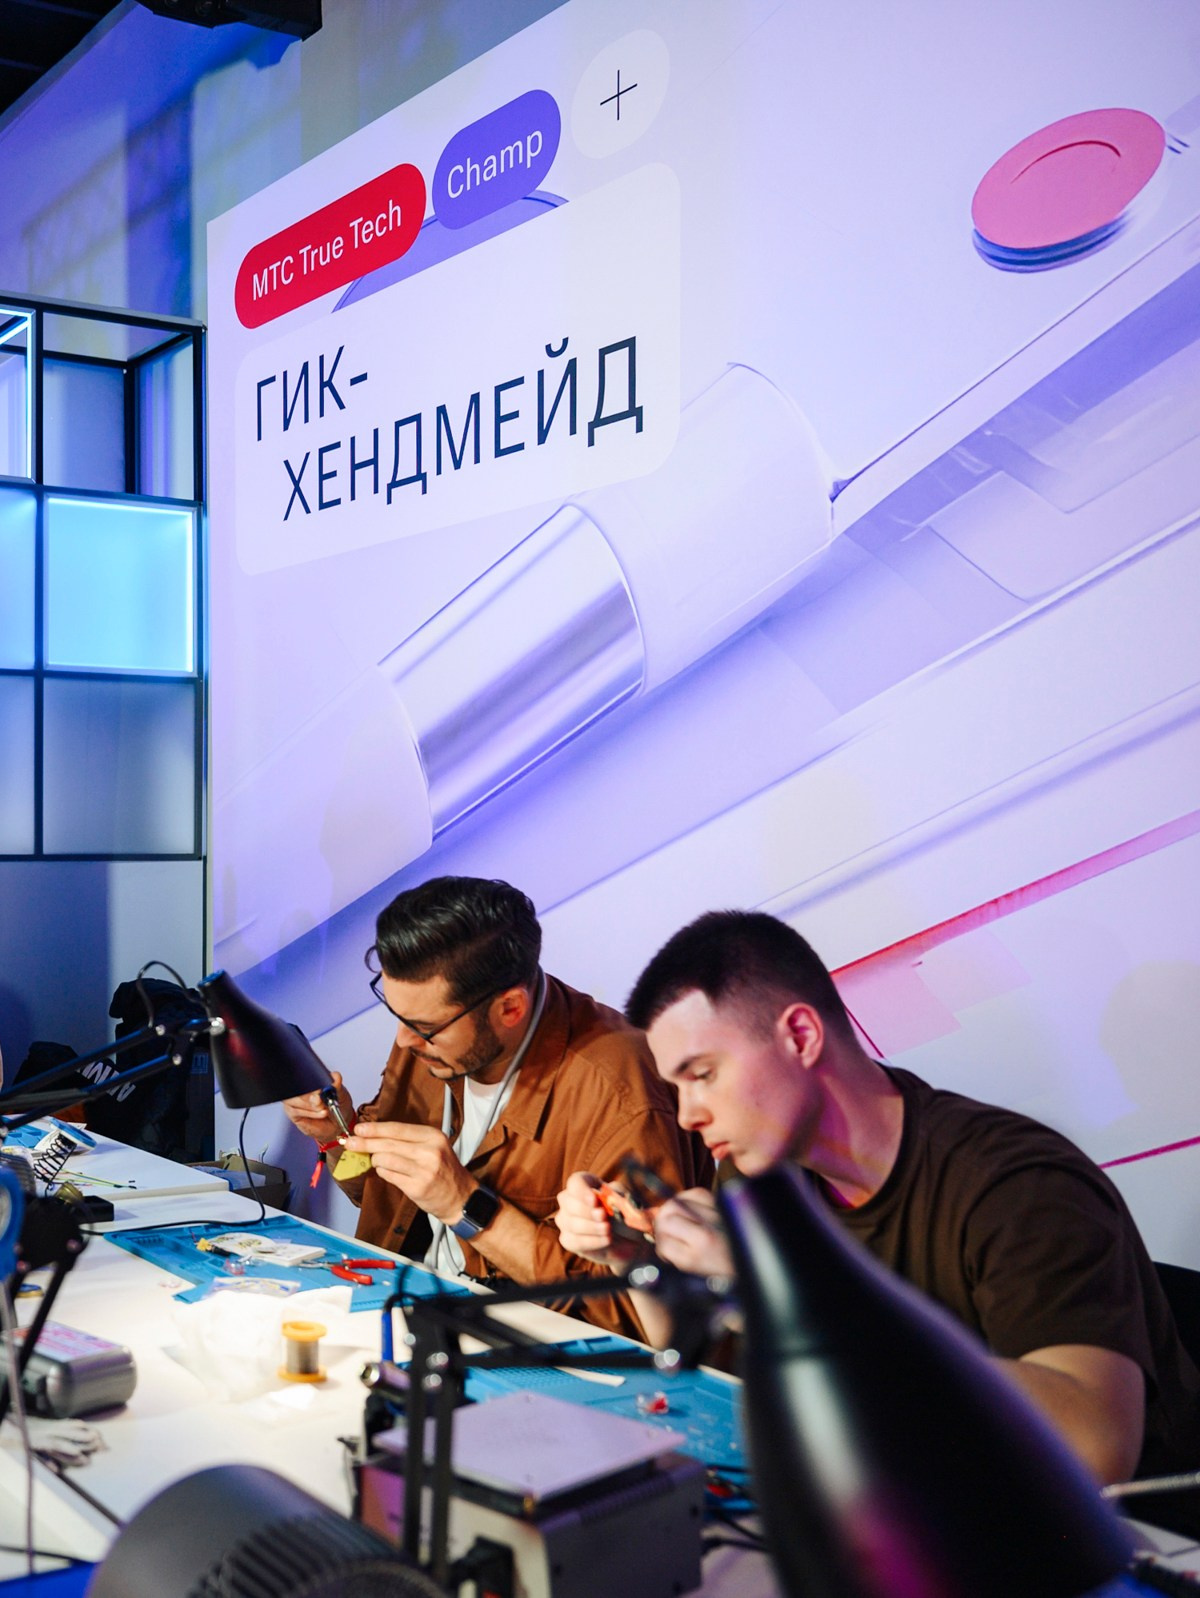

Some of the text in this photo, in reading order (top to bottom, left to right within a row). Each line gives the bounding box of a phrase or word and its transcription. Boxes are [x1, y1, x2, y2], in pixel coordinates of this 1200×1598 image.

[446, 129, 543, 200] Champ
[252, 199, 402, 301] МТС True Tech
[256, 345, 368, 442] ГИК-
[283, 335, 644, 522] ХЕНДМЕЙД
